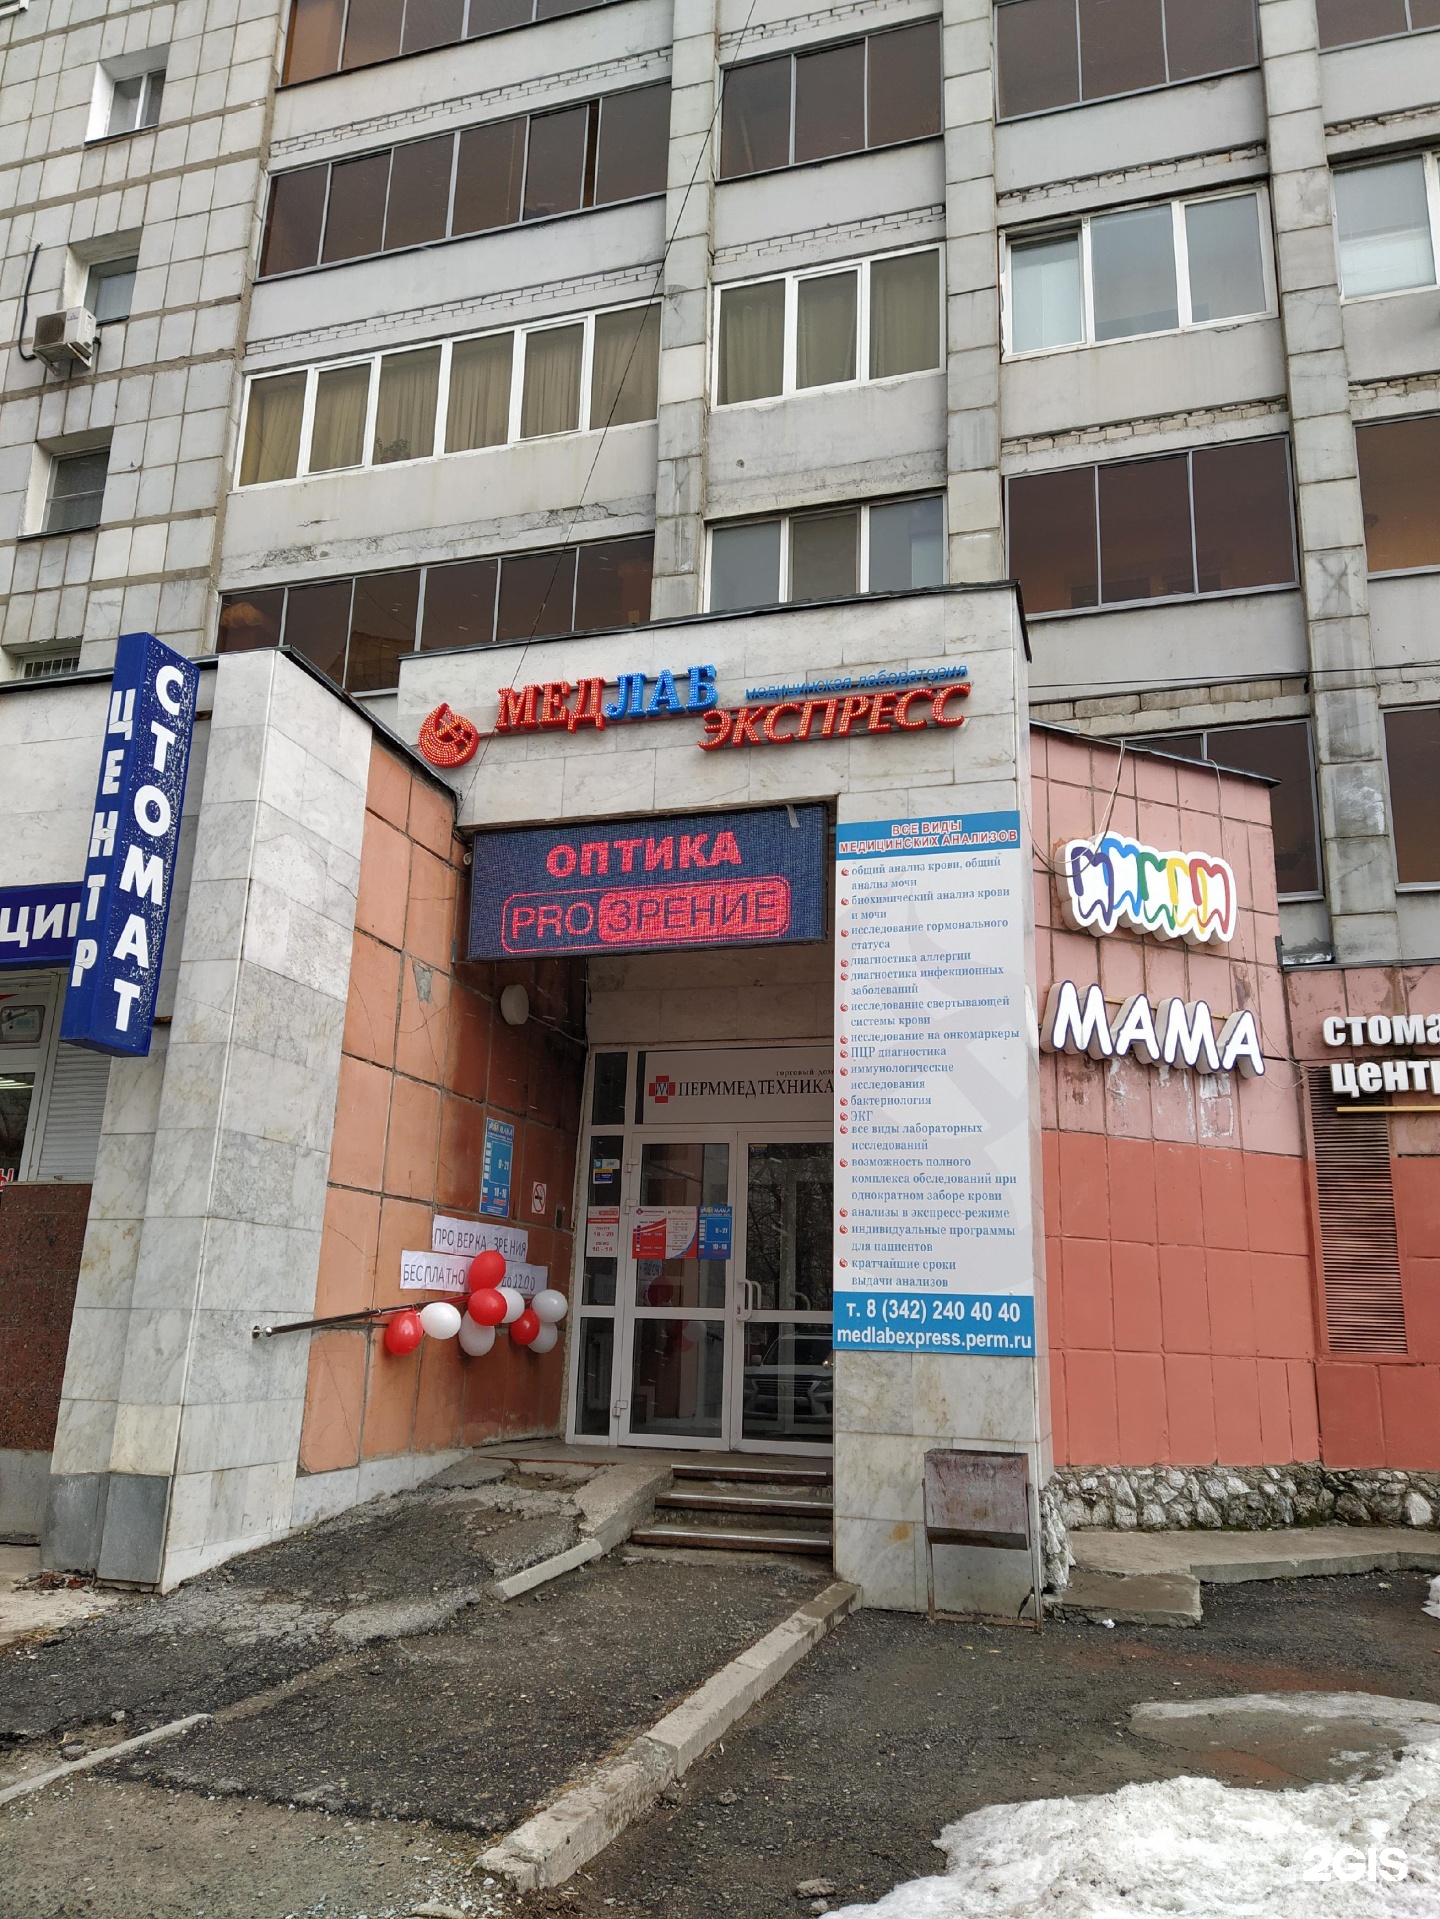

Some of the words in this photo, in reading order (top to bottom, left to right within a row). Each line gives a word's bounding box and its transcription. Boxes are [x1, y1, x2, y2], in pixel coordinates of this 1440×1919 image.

[745, 676, 852, 700] медицинская
[857, 664, 968, 688] лаборатория
[495, 664, 718, 734] МЕДЛАБ
[698, 683, 971, 751] ЭКСПРЕСС
[892, 822, 919, 836] ВСЕ
[922, 819, 962, 835] ВИДЫ
[70, 688, 136, 987] ЦЕНТР
[839, 835, 939, 854] МЕДИЦИНСКИХ
[941, 830, 1018, 846] АНАЛИЗОВ
[113, 664, 185, 1032] СТОМАТ
[546, 831, 742, 878] ОПТИКА
[852, 863, 885, 876] общий
[888, 863, 925, 873] анализ
[928, 861, 962, 873] крови,
[965, 856, 1001, 868] общий
[852, 881, 888, 891] анализ
[891, 879, 917, 889] мочи
[852, 890, 933, 905] биохимический
[937, 891, 974, 901] анализ
[977, 888, 1010, 901] крови
[851, 912, 858, 920] и
[861, 911, 887, 920] мочи
[851, 924, 924, 935] исследование
[926, 919, 1009, 933] гормонального
[851, 940, 890, 951] статуса
[850, 955, 917, 966] диагностика
[920, 952, 971, 963] аллергии
[850, 970, 917, 981] диагностика
[920, 966, 1004, 980] инфекционных
[851, 983, 918, 996] заболеваний
[851, 1000, 924, 1012] исследование
[927, 995, 1010, 1009] свертывающей
[851, 1017, 895, 1026] системы
[898, 1016, 931, 1027] крови
[1051, 979, 1266, 1077] МАМА
[851, 1032, 924, 1042] исследование
[927, 1032, 941, 1040] на
[943, 1029, 1020, 1041] онкомаркеры
[851, 1046, 876, 1059] ПЦР
[878, 1047, 947, 1058] диагностика
[776, 1068, 815, 1077] торговый
[851, 1062, 954, 1075] иммунологические
[851, 1080, 925, 1091] исследования
[851, 1095, 932, 1107] бактериология
[851, 1110, 873, 1122] ЭКГ
[852, 1126, 868, 1134] все
[872, 1126, 899, 1135] виды
[902, 1122, 982, 1135] лабораторных
[852, 1139, 928, 1151] исследований
[852, 1158, 923, 1167] возможность
[926, 1157, 971, 1167] полного
[852, 1175, 910, 1184] комплекса
[913, 1173, 991, 1184] обследований
[995, 1175, 1017, 1186] при
[852, 1191, 924, 1202] однократном
[927, 1189, 964, 1203] заборе
[968, 1192, 1002, 1203] крови
[852, 1208, 899, 1218] анализы
[902, 1209, 908, 1217] в
[911, 1209, 1009, 1220] экспресс-режиме
[852, 1225, 946, 1236] индивидуальные
[950, 1226, 1015, 1237] программы
[852, 1243, 871, 1252] для
[874, 1243, 933, 1252] пациентов
[852, 1258, 920, 1269] кратчайшие
[923, 1261, 956, 1272] сроки
[403, 1264, 466, 1286] БЕСПЛАТНО
[852, 1277, 892, 1287] выдачи
[896, 1278, 948, 1287] анализов
[866, 1298, 877, 1318] 8
[882, 1299, 927, 1324] (342)
[932, 1301, 965, 1321] 240
[970, 1302, 993, 1322] 40
[998, 1302, 1021, 1322] 40
[837, 1325, 1032, 1350] medlabexpress.perm.ru
